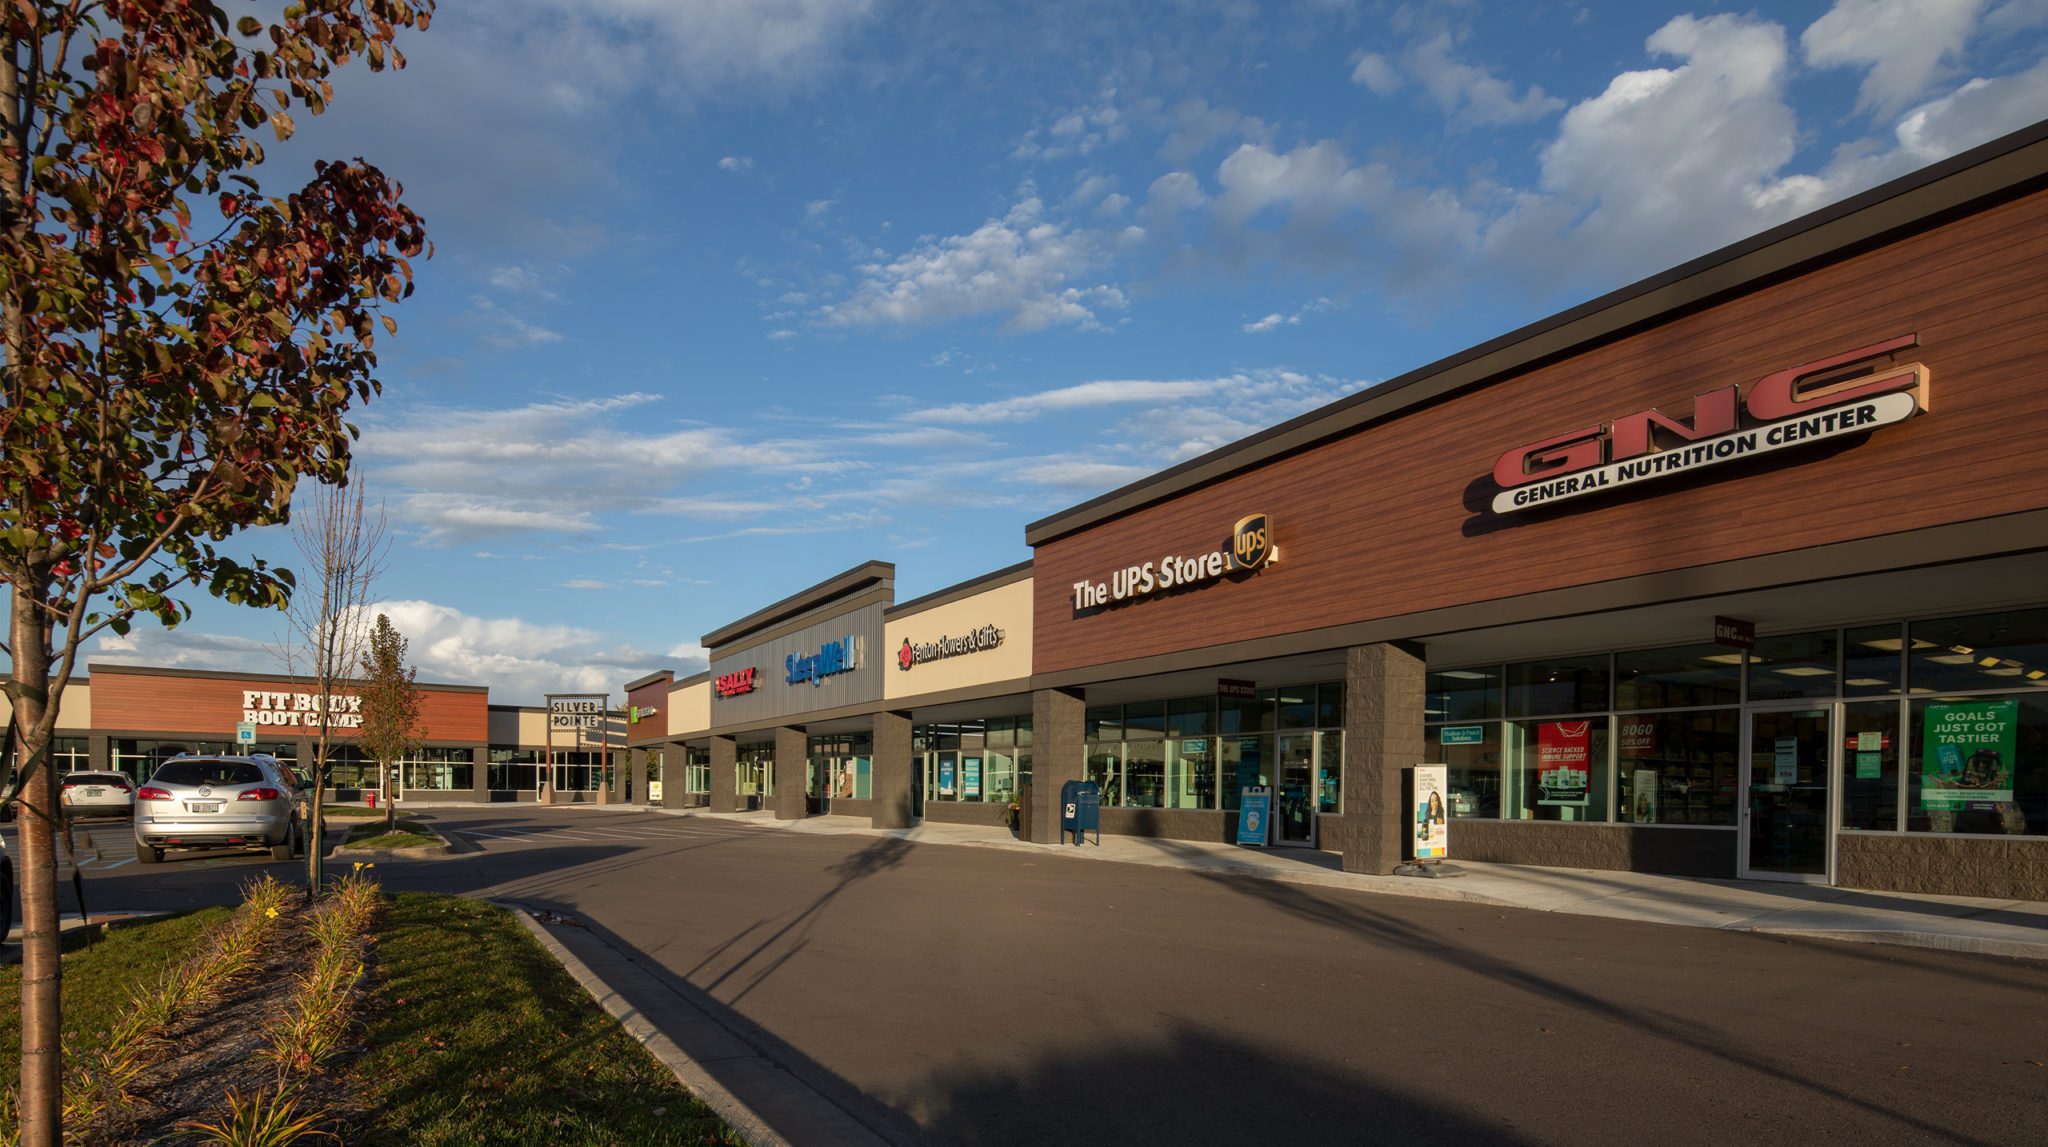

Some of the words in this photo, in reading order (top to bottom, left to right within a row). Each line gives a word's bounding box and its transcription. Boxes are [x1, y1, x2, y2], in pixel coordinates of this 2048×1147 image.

[1493, 332, 1920, 488] GNC
[1513, 472, 1609, 506] GENERAL
[1617, 432, 1757, 480] NUTRITION
[1765, 404, 1878, 446] CENTER
[1073, 580, 1107, 609] The
[1112, 562, 1154, 600] UPS
[1158, 551, 1223, 589] Store
[1717, 624, 1738, 640] GNC
[912, 643, 937, 662] Fenton
[939, 636, 968, 660] Flowers
[969, 629, 977, 649] &
[977, 625, 998, 647] Gifts
[720, 667, 753, 691] SALLY
[1219, 684, 1229, 694] THE
[1229, 685, 1240, 694] UPS
[243, 690, 291, 710] FIT
[554, 702, 595, 713] SILVER
[243, 710, 301, 726] BOOT
[304, 712, 363, 728] CAMP
[554, 715, 596, 726] POINTE
[1945, 711, 1996, 722] GOALS
[1622, 724, 1653, 736] BOGO
[1933, 724, 1971, 733] JUST
[1974, 722, 2007, 731] GOT
[1938, 734, 2000, 743] TASTIER
